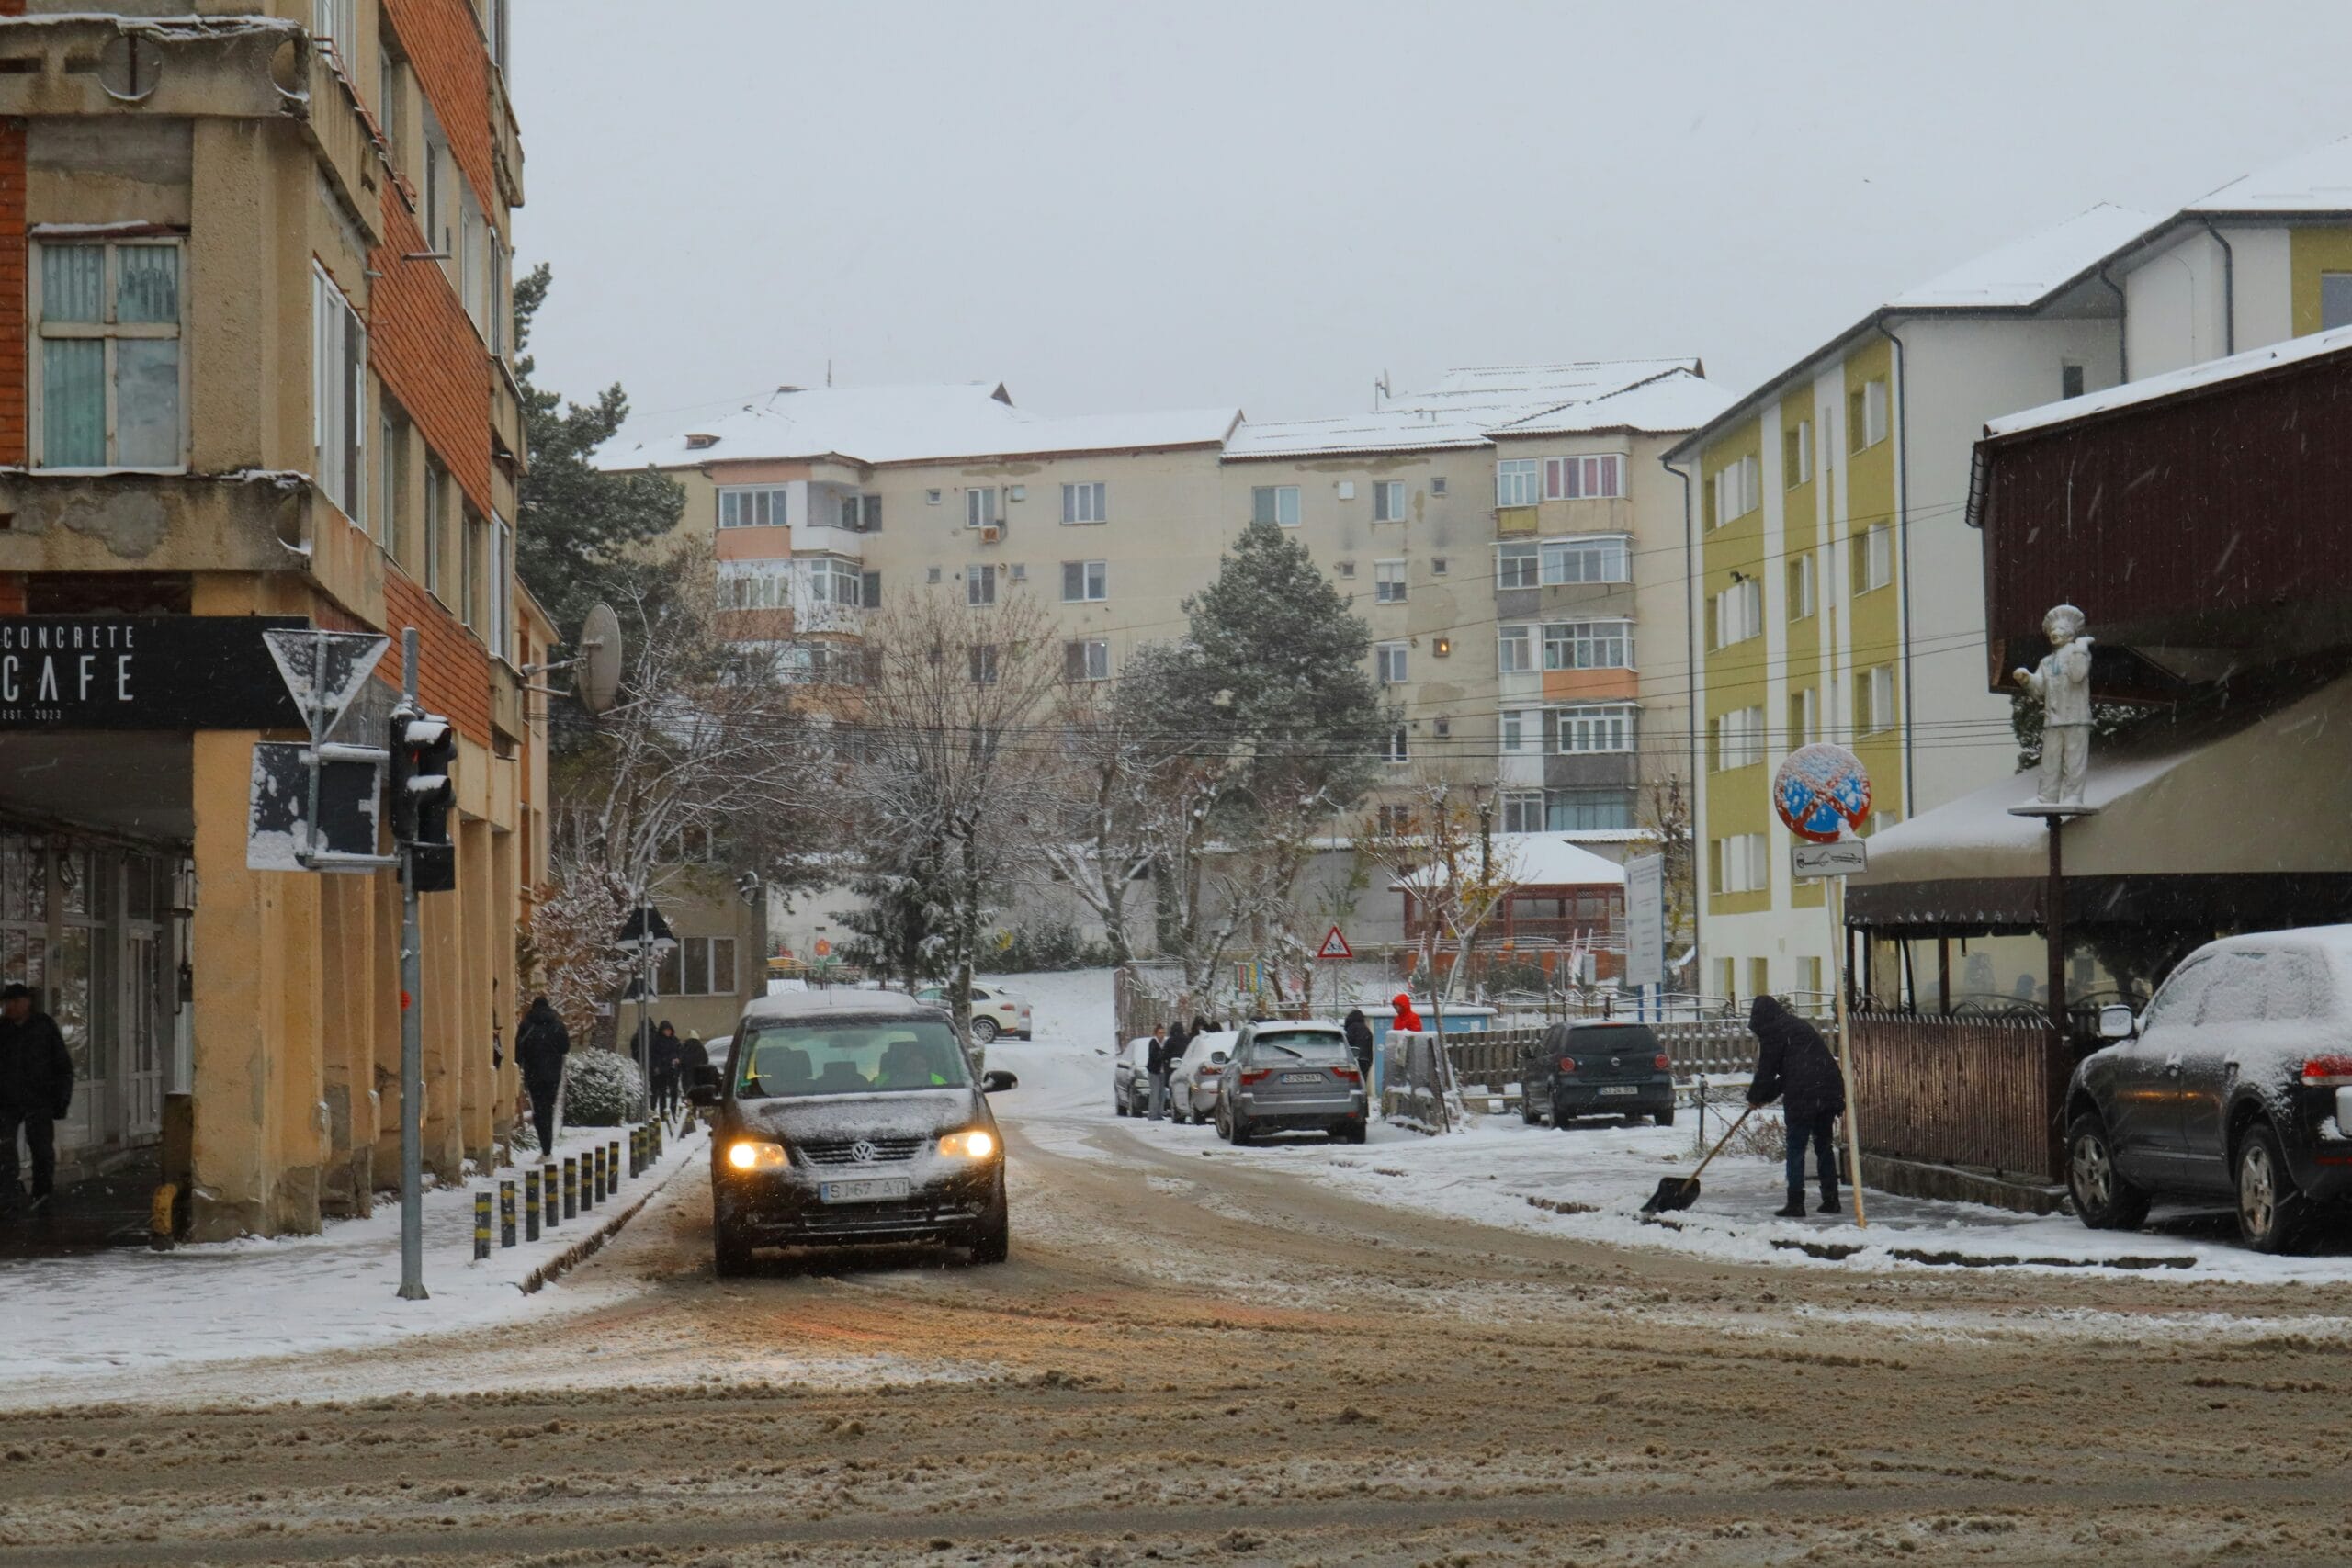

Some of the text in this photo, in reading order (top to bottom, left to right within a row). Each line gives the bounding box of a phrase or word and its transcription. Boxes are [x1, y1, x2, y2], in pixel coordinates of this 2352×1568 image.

[3, 626, 134, 649] CONCRETE
[3, 655, 134, 702] CAFE
[35, 709, 62, 720] 2023
